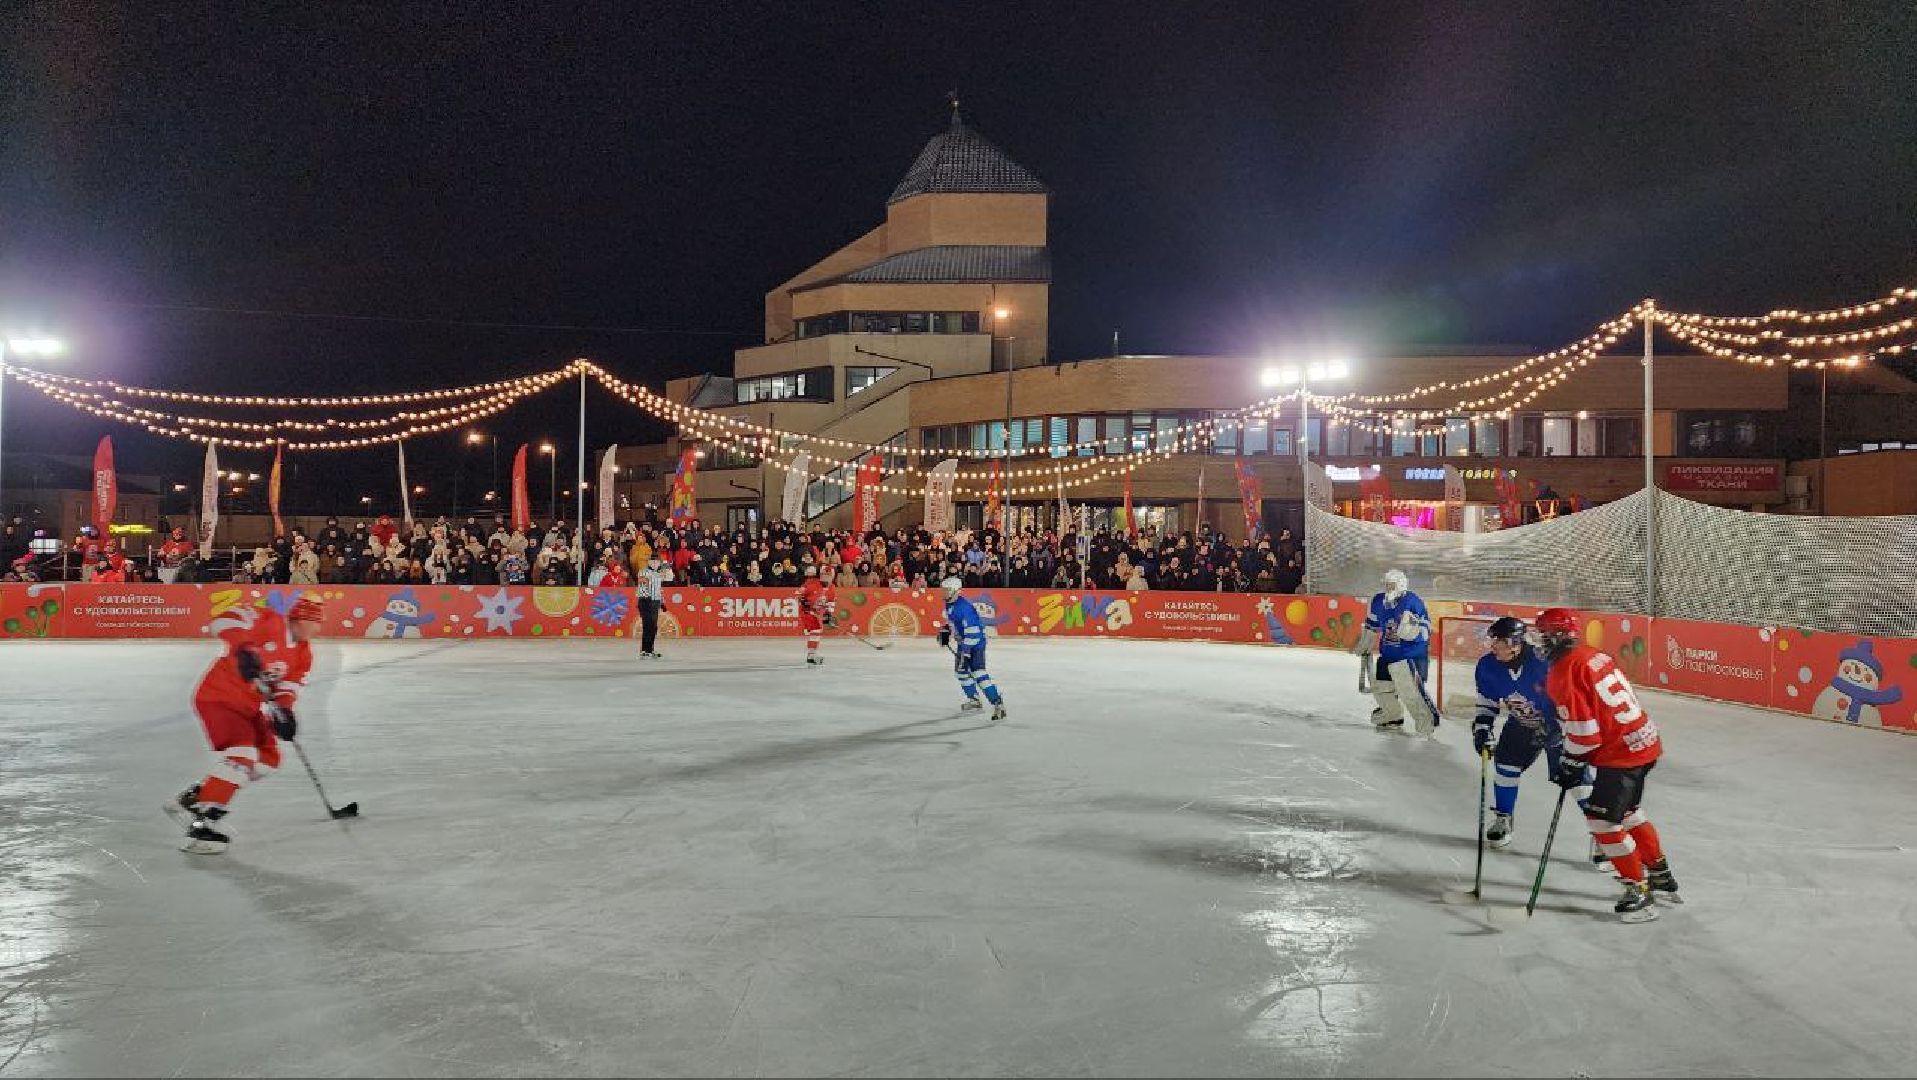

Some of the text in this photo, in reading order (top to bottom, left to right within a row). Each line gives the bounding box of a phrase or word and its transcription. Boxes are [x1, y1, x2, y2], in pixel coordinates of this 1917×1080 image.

[1698, 480, 1748, 489] ТКАНИ
[98, 593, 165, 604] КАТАЙТЕСЬ
[73, 607, 82, 615] С
[1164, 601, 1219, 611] КАТАЙТЕСЬ
[1686, 648, 1718, 661] ПАРКИ
